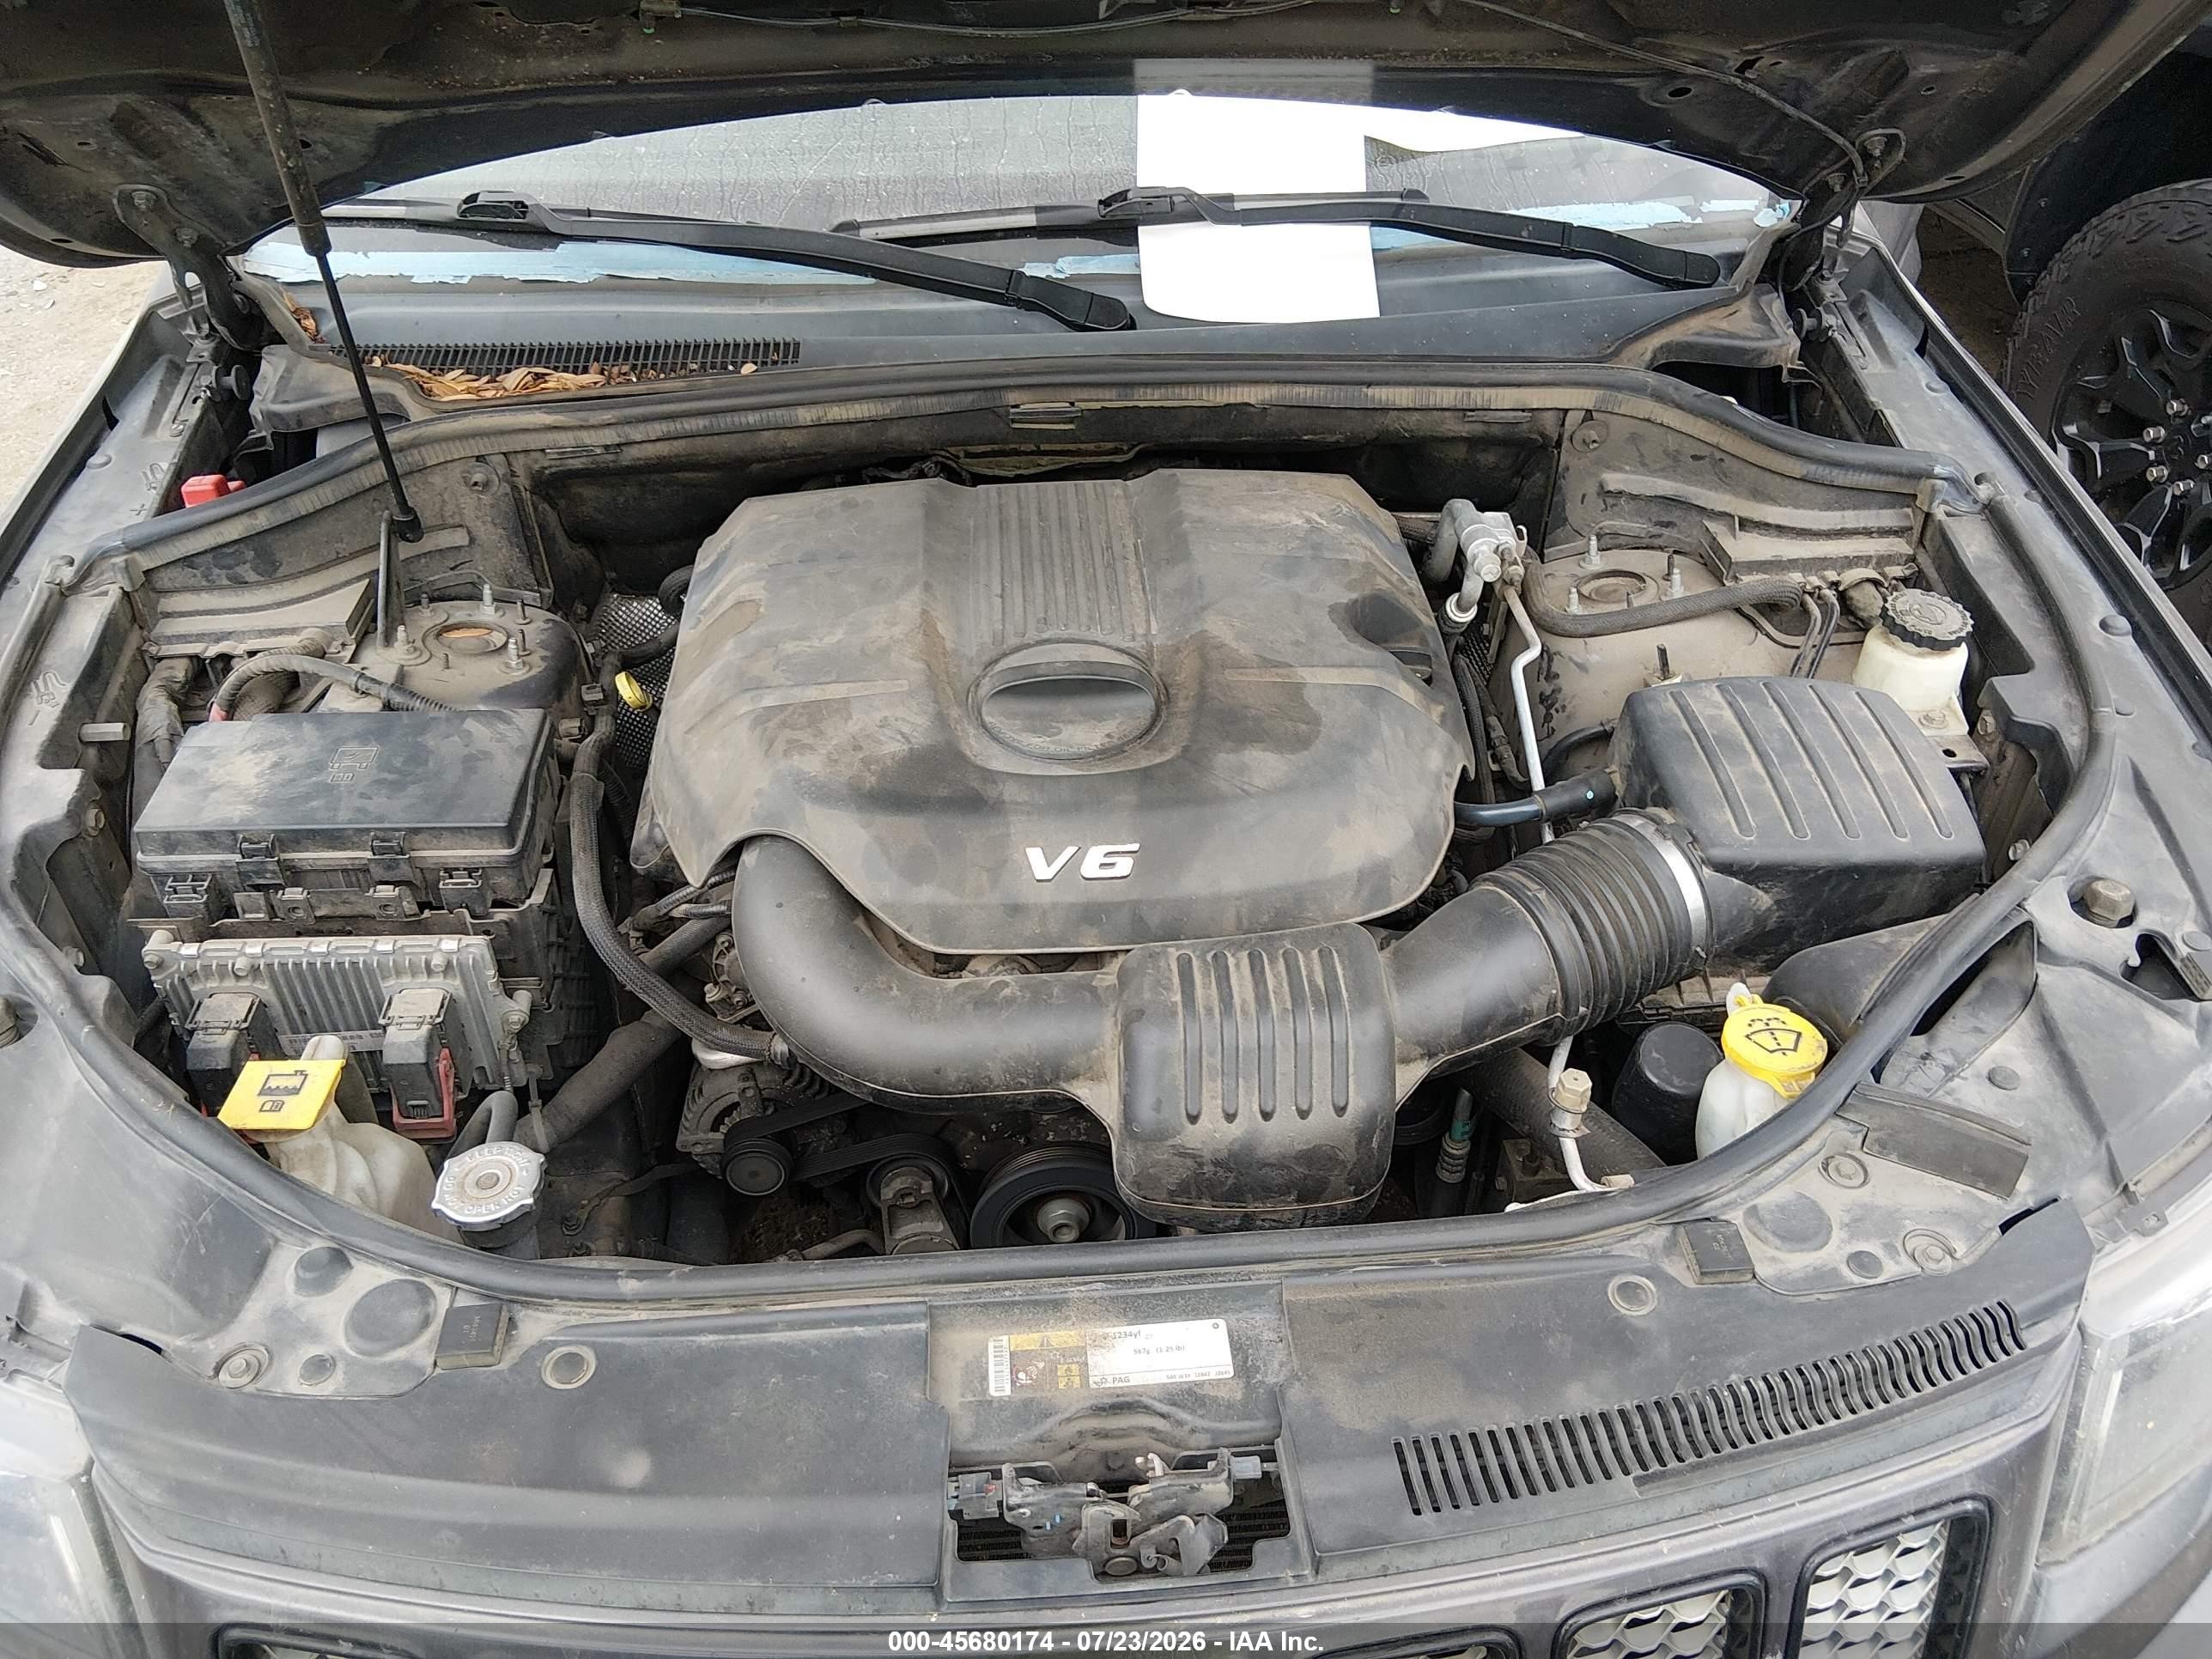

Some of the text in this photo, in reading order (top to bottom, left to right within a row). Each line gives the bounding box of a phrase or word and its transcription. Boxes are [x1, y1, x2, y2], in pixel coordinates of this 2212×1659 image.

[1025, 843, 1140, 883] V6
[465, 1203, 501, 1215] OPEN
[1112, 1375, 1131, 1385] PAG
